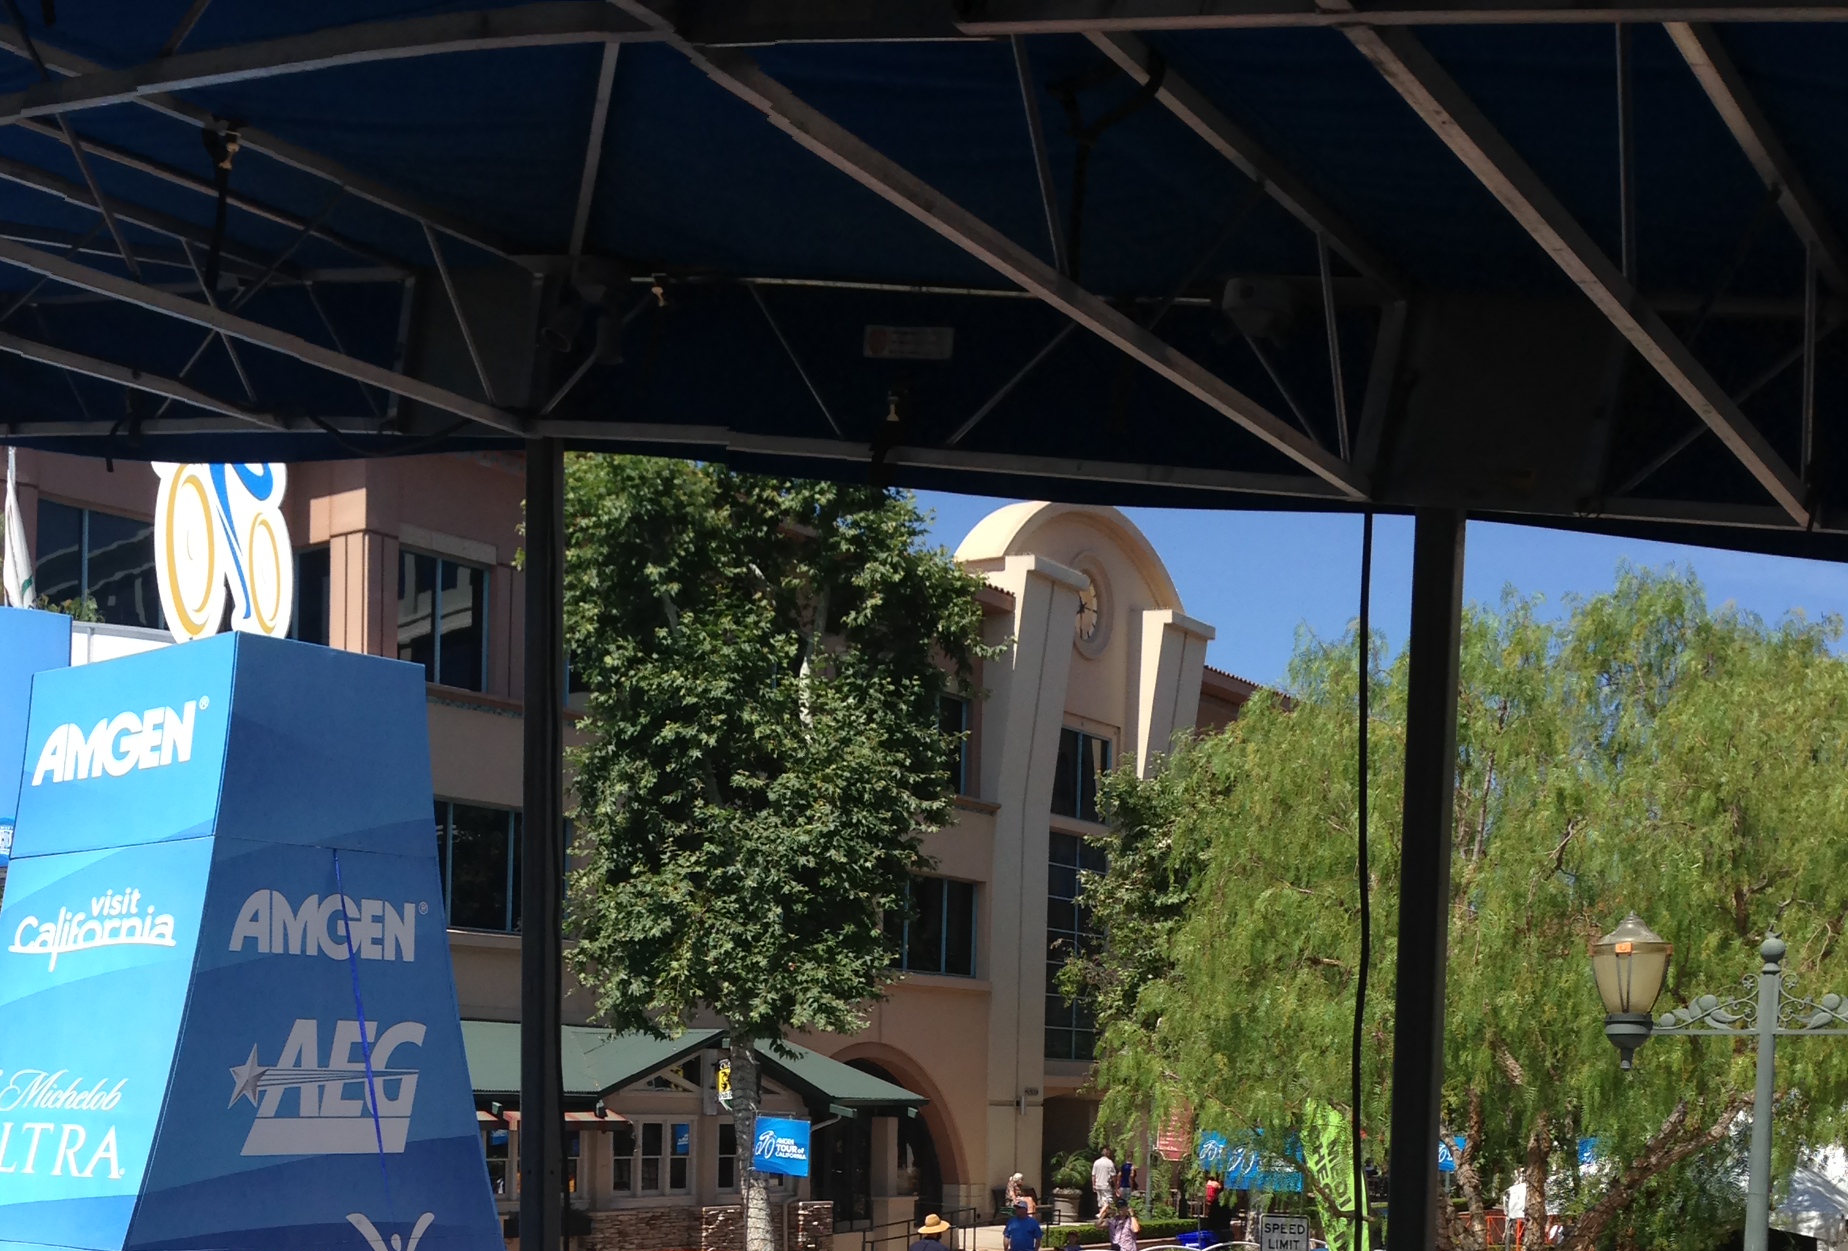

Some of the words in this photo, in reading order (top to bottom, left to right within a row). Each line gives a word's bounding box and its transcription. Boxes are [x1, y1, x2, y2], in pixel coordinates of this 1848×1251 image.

[31, 698, 200, 788] AMGEN
[90, 887, 142, 918] visit
[8, 906, 178, 974] California
[228, 889, 418, 964] AMGEN
[253, 1018, 429, 1118] AEG
[776, 1144, 797, 1152] TOUR
[776, 1152, 806, 1160] CALIFORNIA
[1264, 1222, 1305, 1235] SPEED
[1268, 1239, 1299, 1250] LIMIT
